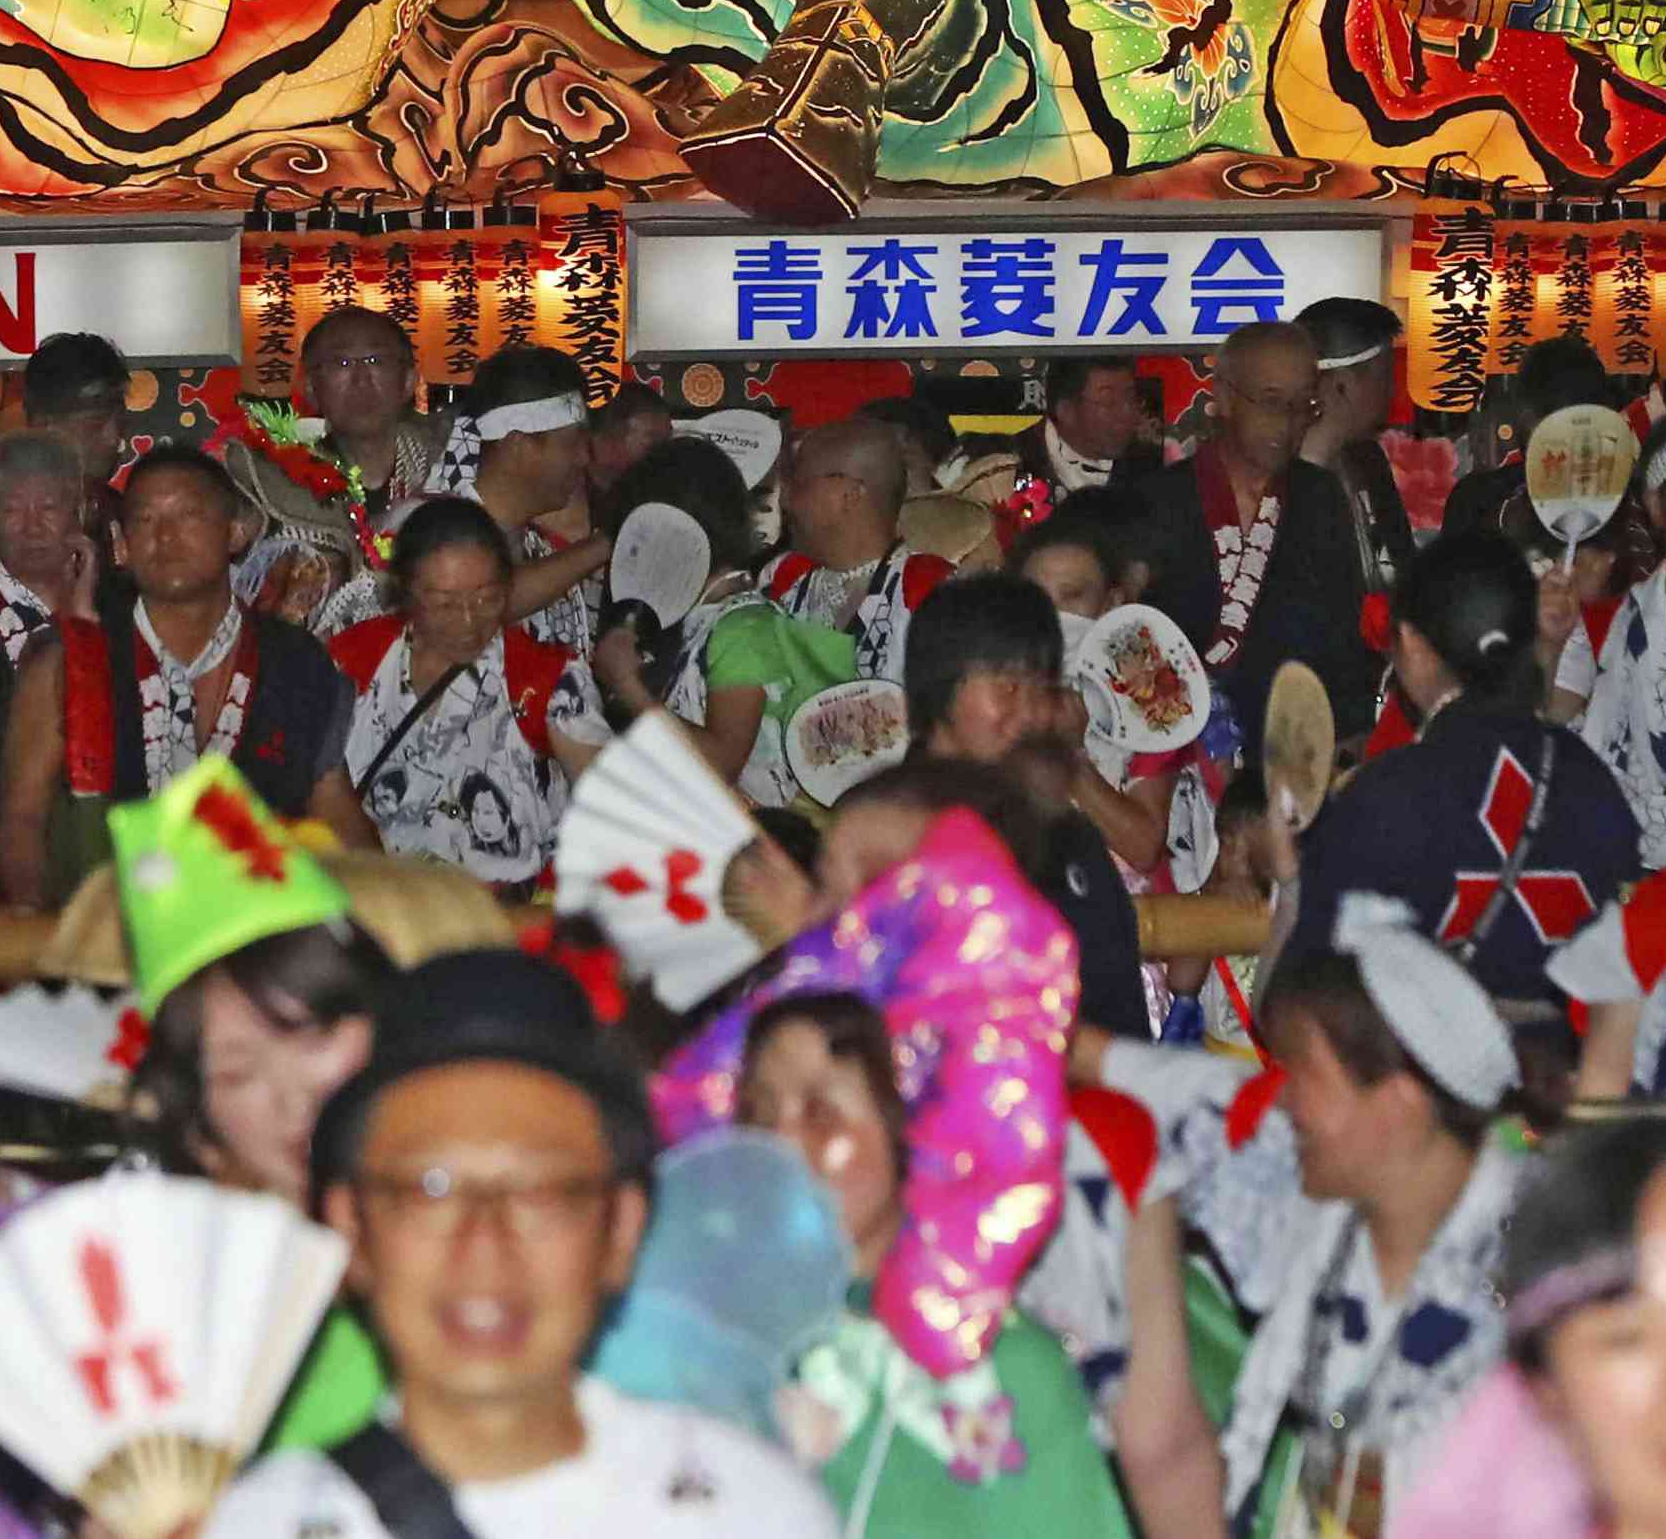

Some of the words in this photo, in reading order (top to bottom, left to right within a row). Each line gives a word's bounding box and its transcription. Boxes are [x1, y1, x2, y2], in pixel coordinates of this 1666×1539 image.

[255, 243, 297, 385] 青森菱友会
[444, 239, 480, 375] 青森菱友会
[554, 203, 623, 403] 青森菱友会
[732, 238, 1287, 341] 青森菱友会
[1427, 206, 1495, 409] 青森菱友会
[1497, 232, 1535, 366] 青森菱友会
[1612, 229, 1653, 365] 青森菱友会
